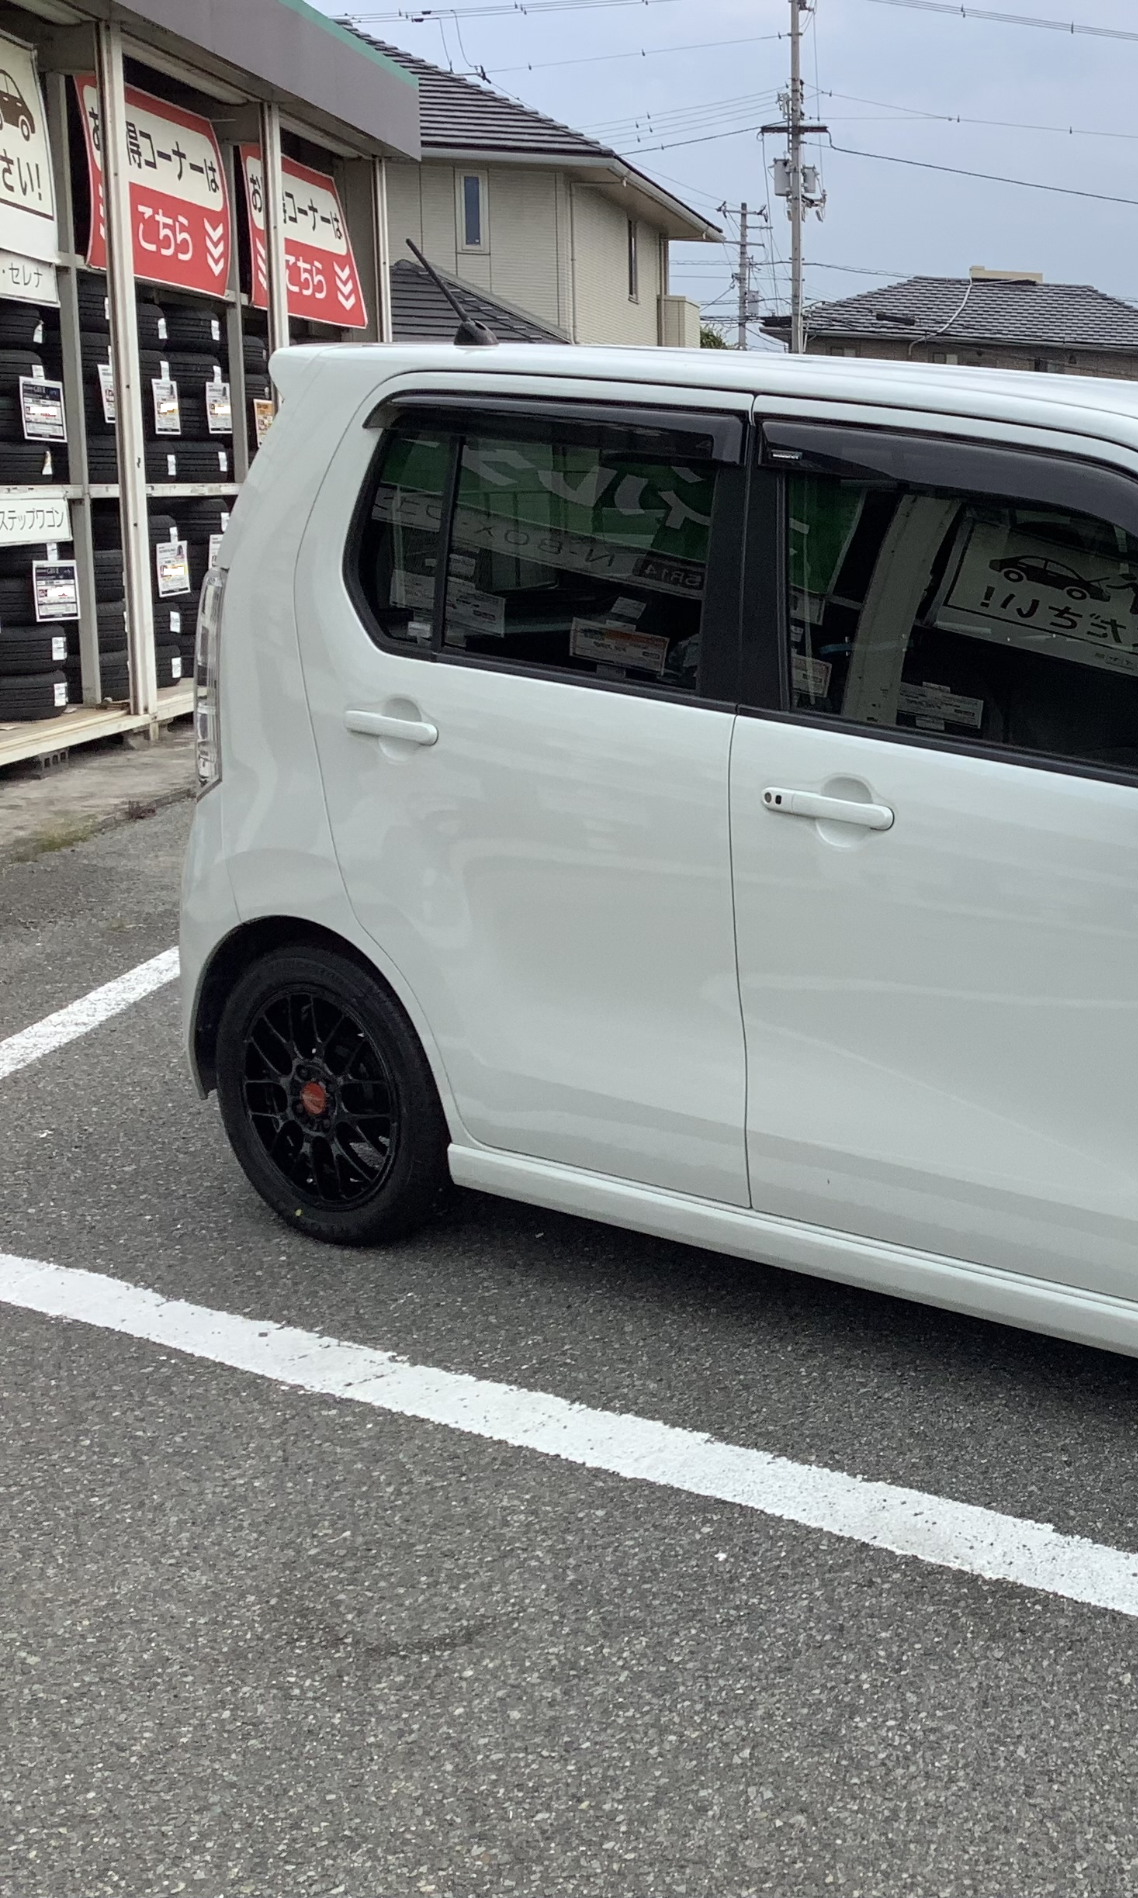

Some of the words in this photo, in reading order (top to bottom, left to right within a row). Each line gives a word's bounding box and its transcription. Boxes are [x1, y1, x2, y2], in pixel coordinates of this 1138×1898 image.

[137, 204, 193, 261] こちら
[285, 254, 327, 299] こちら
[0, 507, 64, 531] ステップワゴン
